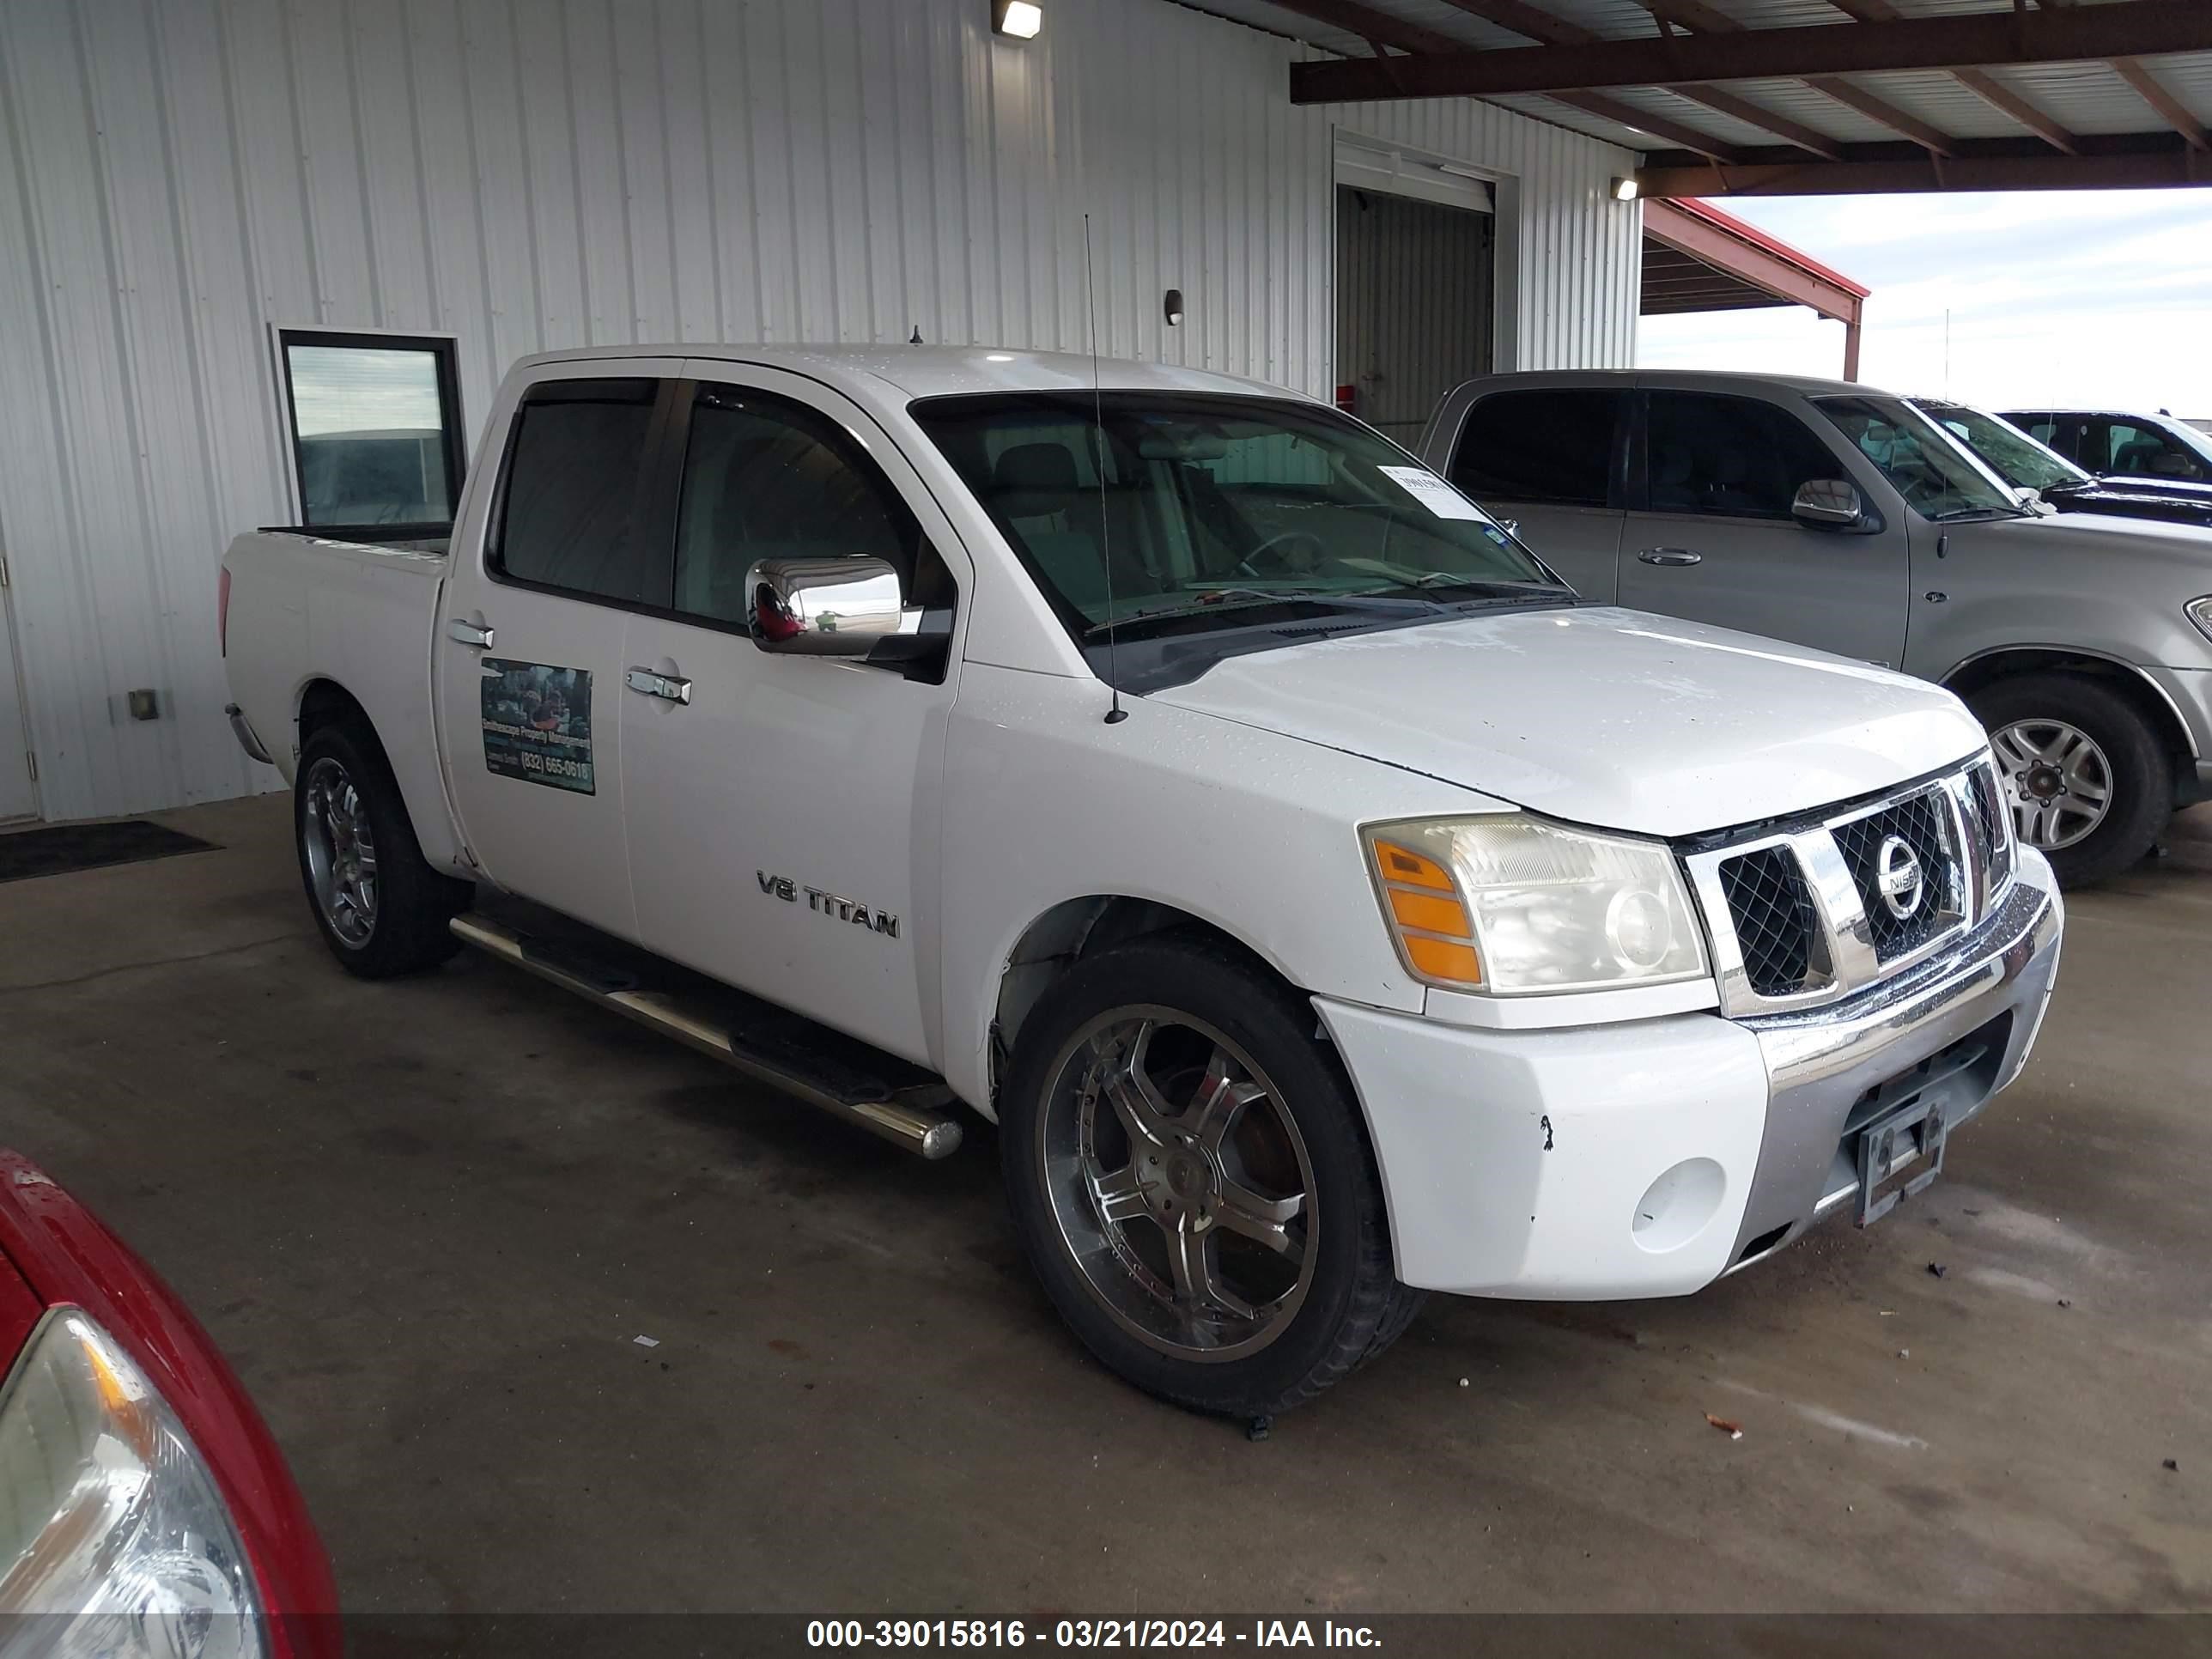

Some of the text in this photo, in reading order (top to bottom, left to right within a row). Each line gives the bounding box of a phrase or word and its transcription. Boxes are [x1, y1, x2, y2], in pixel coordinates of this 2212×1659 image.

[522, 751, 544, 774] (832)
[757, 869, 901, 939] V8 TITAN
